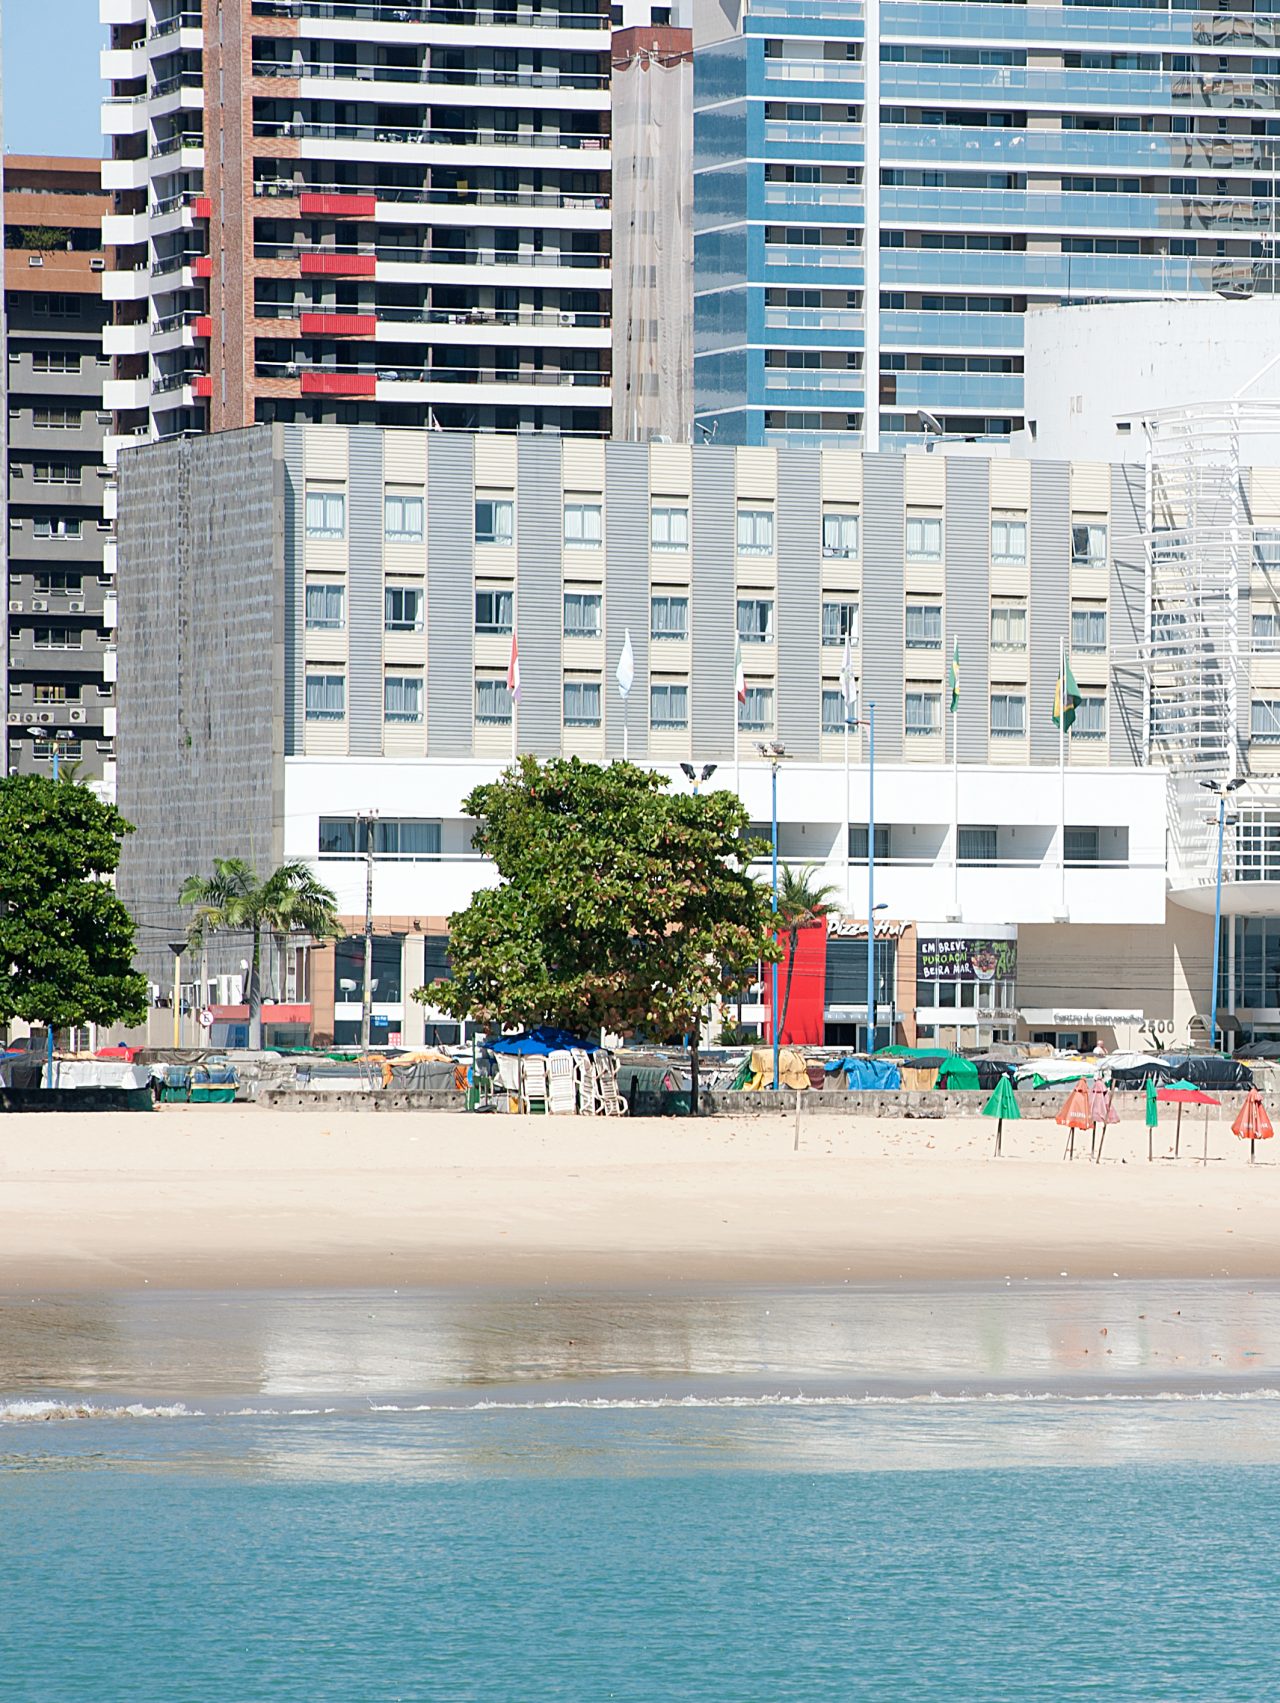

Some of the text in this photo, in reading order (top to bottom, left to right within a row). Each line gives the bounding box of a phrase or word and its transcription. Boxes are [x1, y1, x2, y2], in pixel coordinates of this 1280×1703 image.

[828, 919, 912, 938] Pizza Hut
[922, 943, 935, 953] EM
[1138, 1020, 1175, 1034] 2500
